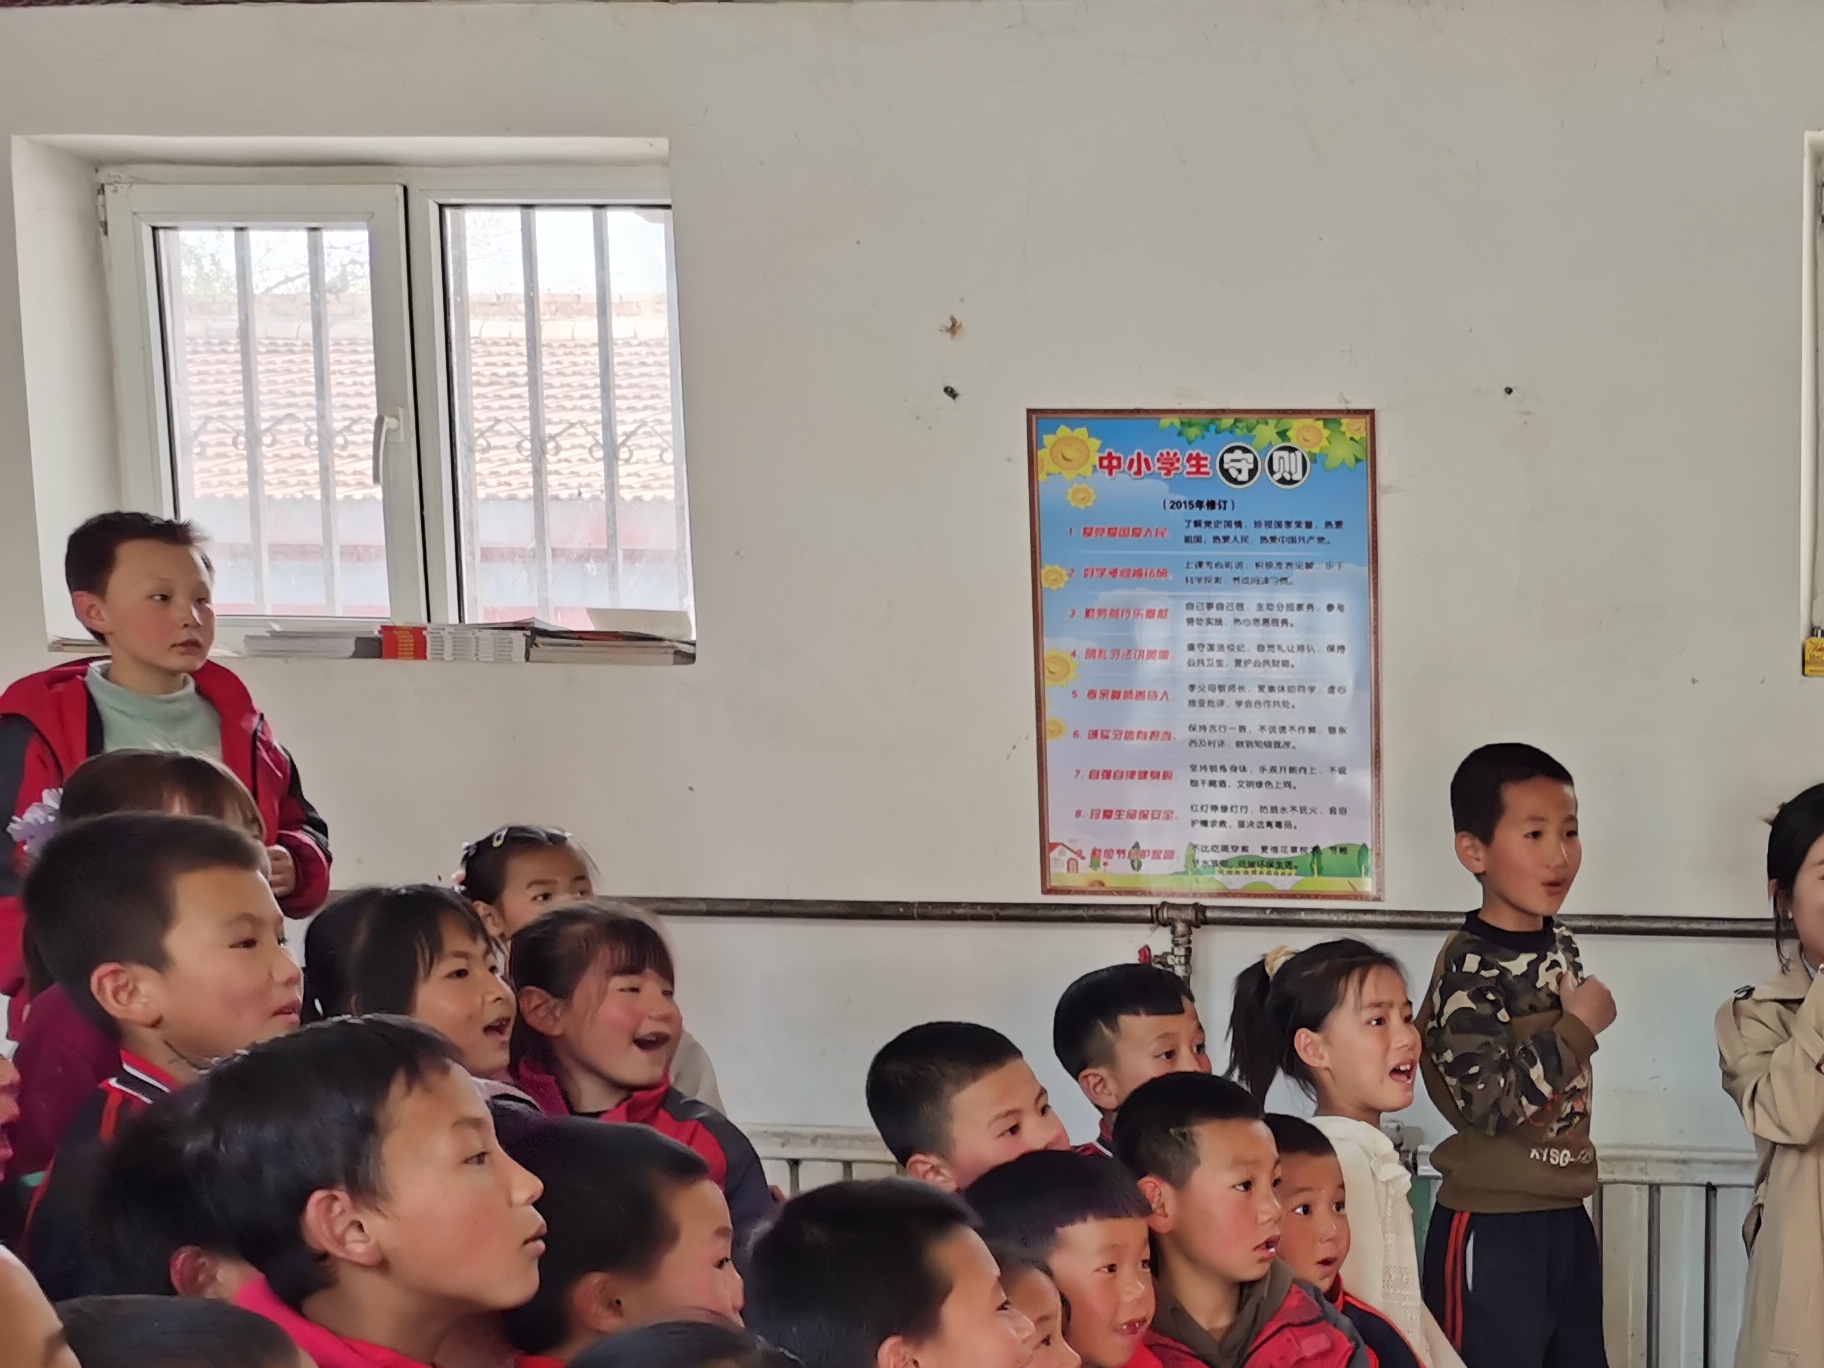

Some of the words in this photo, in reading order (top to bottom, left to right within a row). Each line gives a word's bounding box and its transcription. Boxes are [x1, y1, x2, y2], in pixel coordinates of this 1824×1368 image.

[1098, 447, 1306, 482] 中小学生守则
